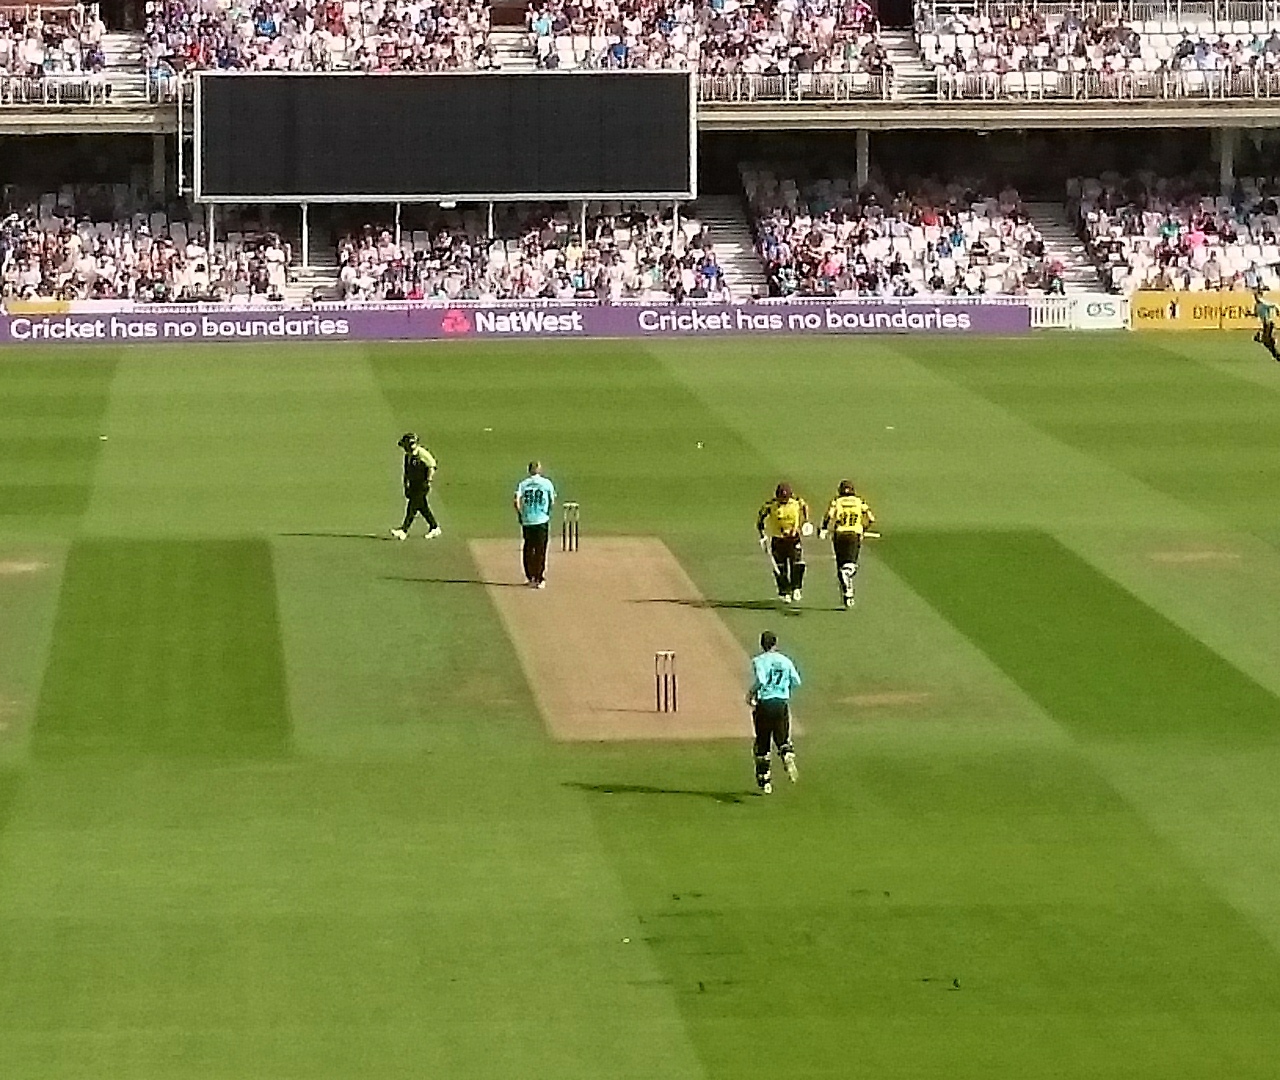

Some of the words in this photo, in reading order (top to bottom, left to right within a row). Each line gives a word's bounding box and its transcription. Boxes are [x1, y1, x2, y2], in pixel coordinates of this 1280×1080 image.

[476, 310, 583, 332] NatWest
[639, 309, 731, 330] Cricket
[737, 309, 782, 329] has
[789, 313, 820, 328] no
[826, 308, 970, 328] boundaries
[1193, 306, 1251, 319] DRIVEN
[10, 318, 105, 339] Cricket
[110, 317, 157, 337] has
[164, 322, 196, 336] no
[202, 315, 349, 336] boundaries
